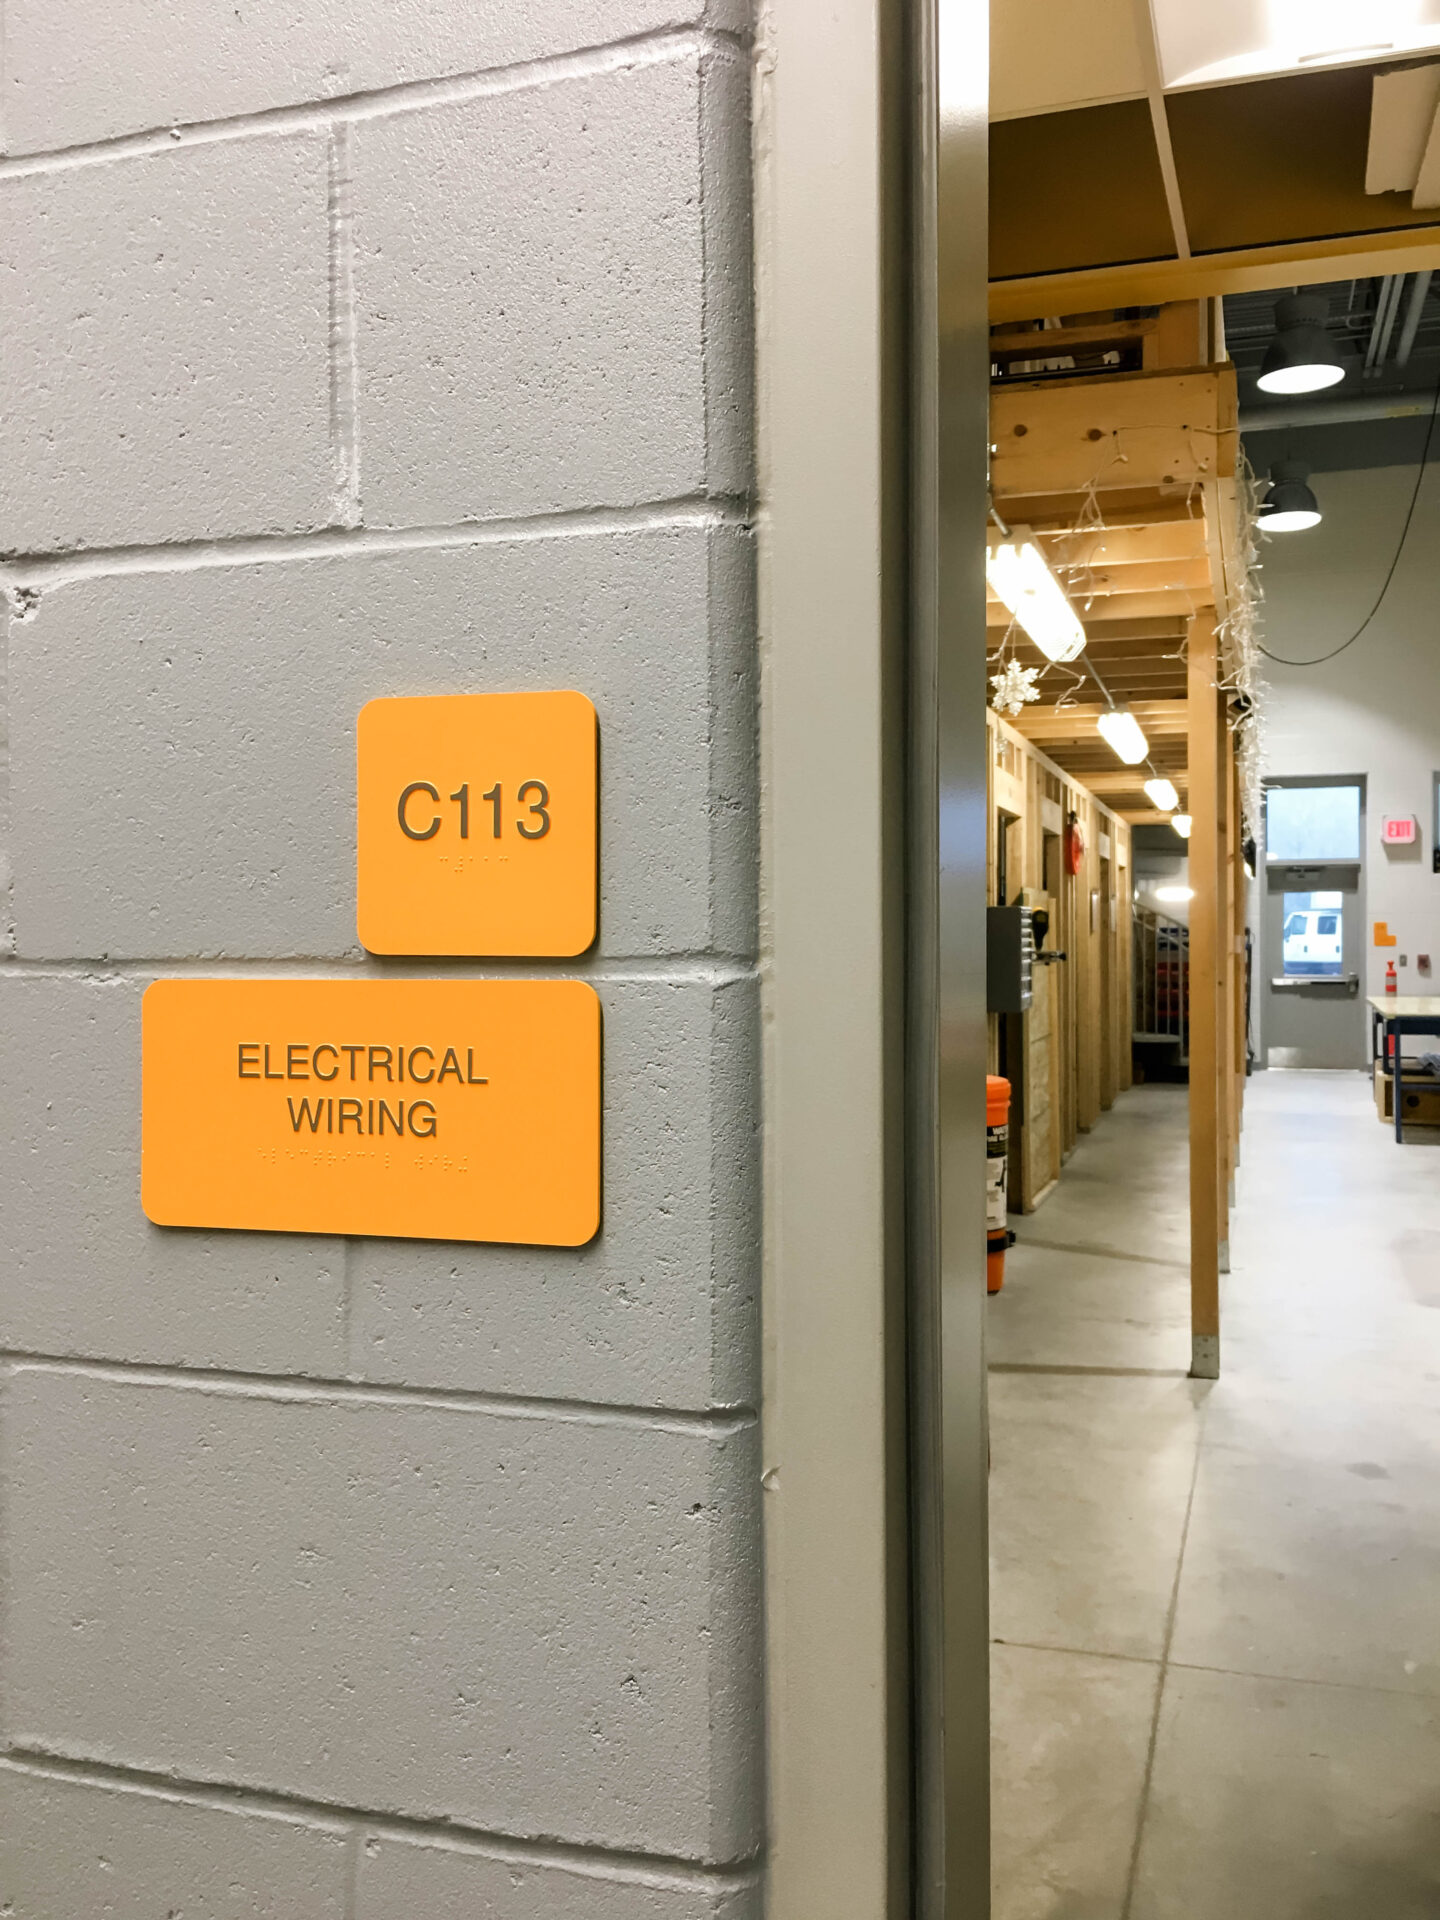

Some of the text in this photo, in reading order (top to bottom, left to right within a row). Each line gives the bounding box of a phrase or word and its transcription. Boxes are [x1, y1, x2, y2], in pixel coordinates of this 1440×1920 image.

[398, 779, 551, 841] C113
[1387, 820, 1412, 838] EXIT
[237, 1042, 489, 1085] ELECTRICAL
[286, 1096, 438, 1138] WIRING
